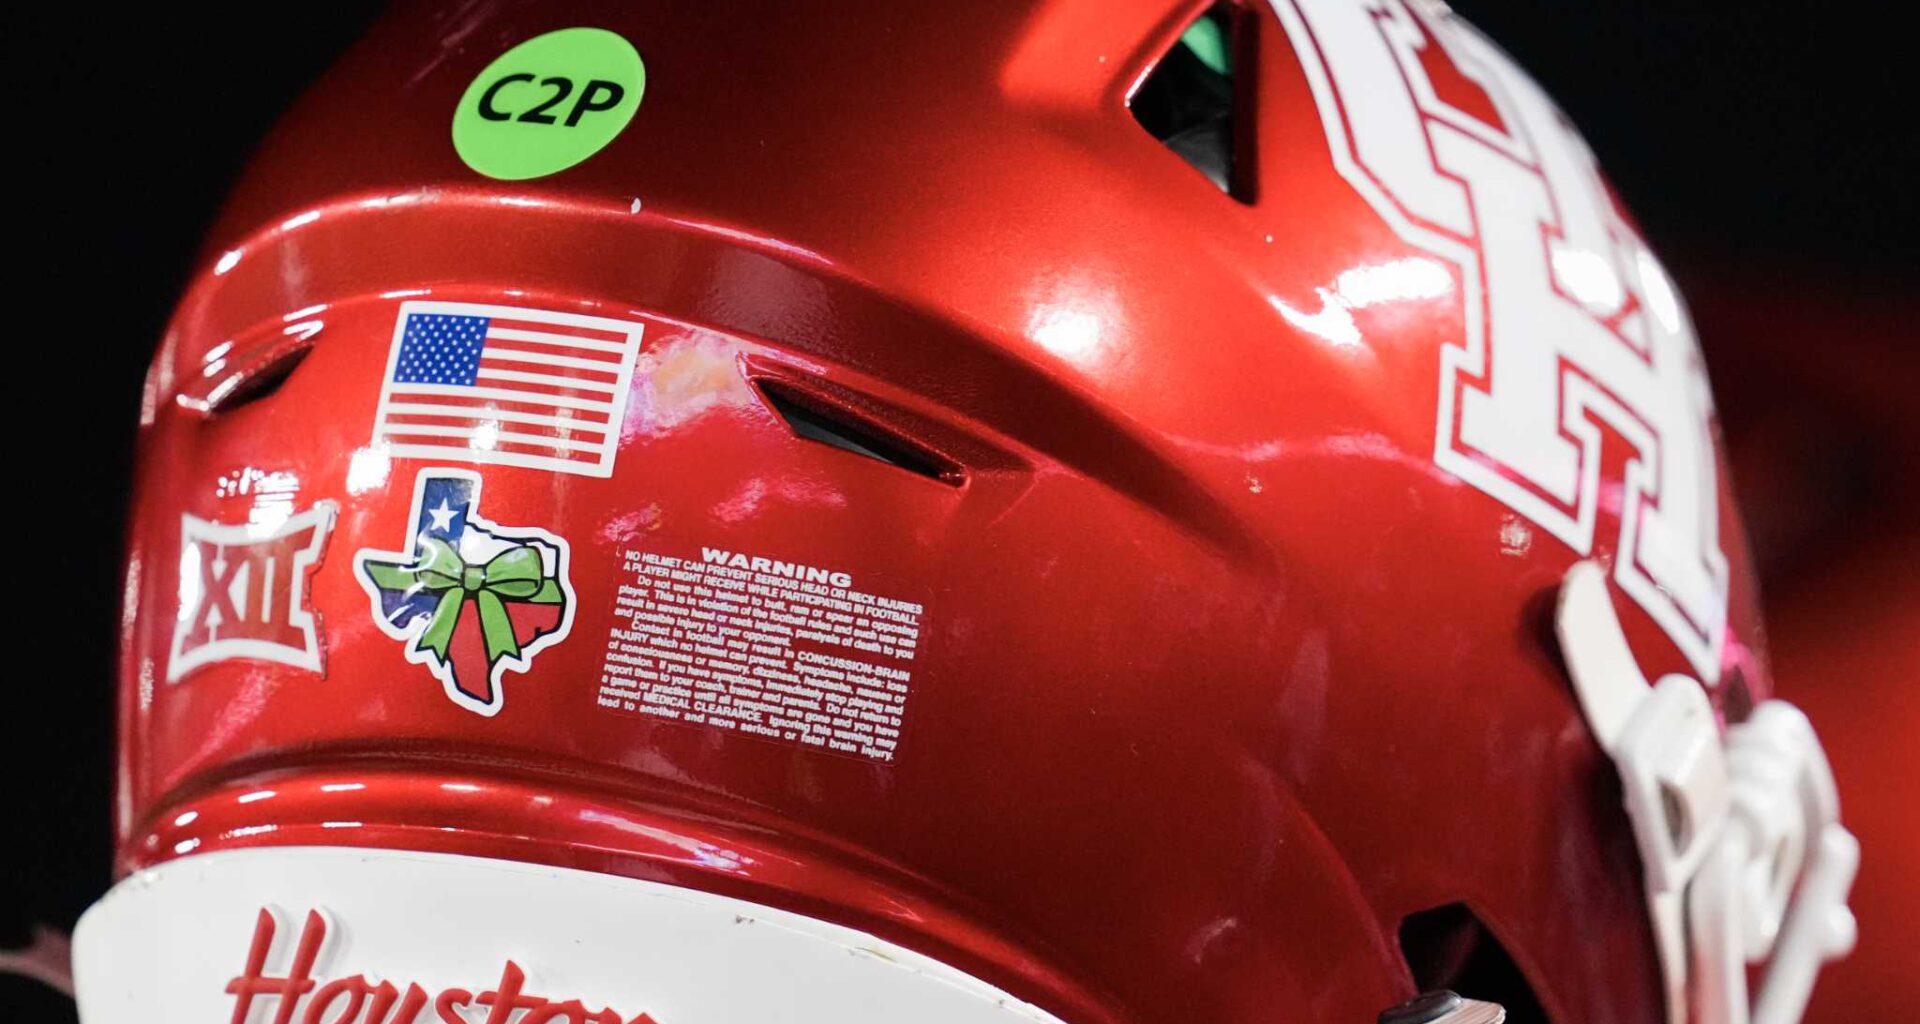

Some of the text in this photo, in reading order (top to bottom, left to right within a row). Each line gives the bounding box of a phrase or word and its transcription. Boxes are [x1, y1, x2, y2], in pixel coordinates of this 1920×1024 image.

[478, 73, 624, 128] C2P
[623, 561, 631, 571] A
[631, 562, 670, 578] PLAYER
[670, 569, 701, 583] MIGHT
[703, 575, 746, 592] RECEIVE
[747, 584, 779, 598] WHILE
[779, 590, 852, 612] PARTICIPATING
[853, 604, 865, 614] IN
[625, 549, 923, 614] NO HELMET CAN PREVENT SERIOUS HEAD OR NECK INJURIES
[701, 547, 851, 588] WARNING
[614, 607, 793, 646] and possible injury to your opponent.
[616, 596, 645, 608] result
[645, 599, 655, 610] in
[656, 603, 690, 616] severe
[690, 608, 716, 621] head
[715, 614, 727, 623] or
[728, 616, 753, 628] neck
[795, 628, 840, 645] paralysis
[853, 639, 882, 653] death
[883, 644, 894, 655] to
[895, 648, 914, 659] you
[618, 584, 650, 597] player.
[655, 590, 675, 602] This
[675, 593, 685, 604] is
[686, 595, 697, 606] in
[698, 598, 739, 613] violation
[752, 608, 768, 619] the
[769, 611, 807, 626] football
[807, 619, 832, 631] rules
[832, 624, 853, 635] and
[852, 628, 877, 640] such
[878, 633, 897, 644] use
[897, 637, 916, 648] can
[637, 575, 652, 586] Do
[653, 580, 671, 589] not
[672, 583, 692, 593] use
[693, 585, 713, 597] this
[714, 589, 749, 604] helmet
[751, 596, 762, 606] to
[789, 605, 810, 615] ram
[811, 609, 823, 618] or
[825, 612, 854, 624] spear
[855, 617, 869, 627] an
[871, 620, 918, 638] opposing
[610, 628, 648, 643] INJURY
[649, 636, 678, 648] which
[679, 642, 693, 652] no
[694, 643, 728, 658] helmet
[728, 651, 748, 661] can
[748, 654, 789, 669] prevent.
[792, 661, 845, 680] Symptoms
[886, 679, 908, 692] loss
[631, 620, 910, 681] Contact in football may result in CONCUSSION-BRAIN
[694, 657, 706, 665] or
[856, 687, 893, 701] nausea
[893, 695, 906, 703] or
[601, 674, 899, 737] a game or practice until all symptoms are gone and you have
[603, 663, 633, 676] report
[634, 667, 659, 680] them
[659, 672, 670, 682] to
[671, 676, 694, 686] your
[728, 684, 760, 698] trainer
[761, 692, 782, 703] and
[781, 695, 823, 710] parents.
[825, 703, 841, 714] Do
[841, 707, 859, 718] not
[859, 711, 889, 724] return
[890, 716, 901, 726] to
[606, 652, 655, 667] confusion.
[658, 660, 667, 670] If
[667, 663, 686, 673] you
[686, 665, 711, 678] have
[765, 680, 824, 701] immediately
[824, 692, 847, 705] stop
[847, 696, 884, 713] playing
[884, 704, 904, 715] and
[597, 695, 895, 761] lead to another and more serious or fatal brain injury.
[599, 685, 641, 700] received
[642, 691, 691, 709] MEDICAL
[768, 715, 811, 734] Ignoring
[812, 723, 832, 736] this
[833, 729, 874, 746] warning
[875, 737, 897, 750] may
